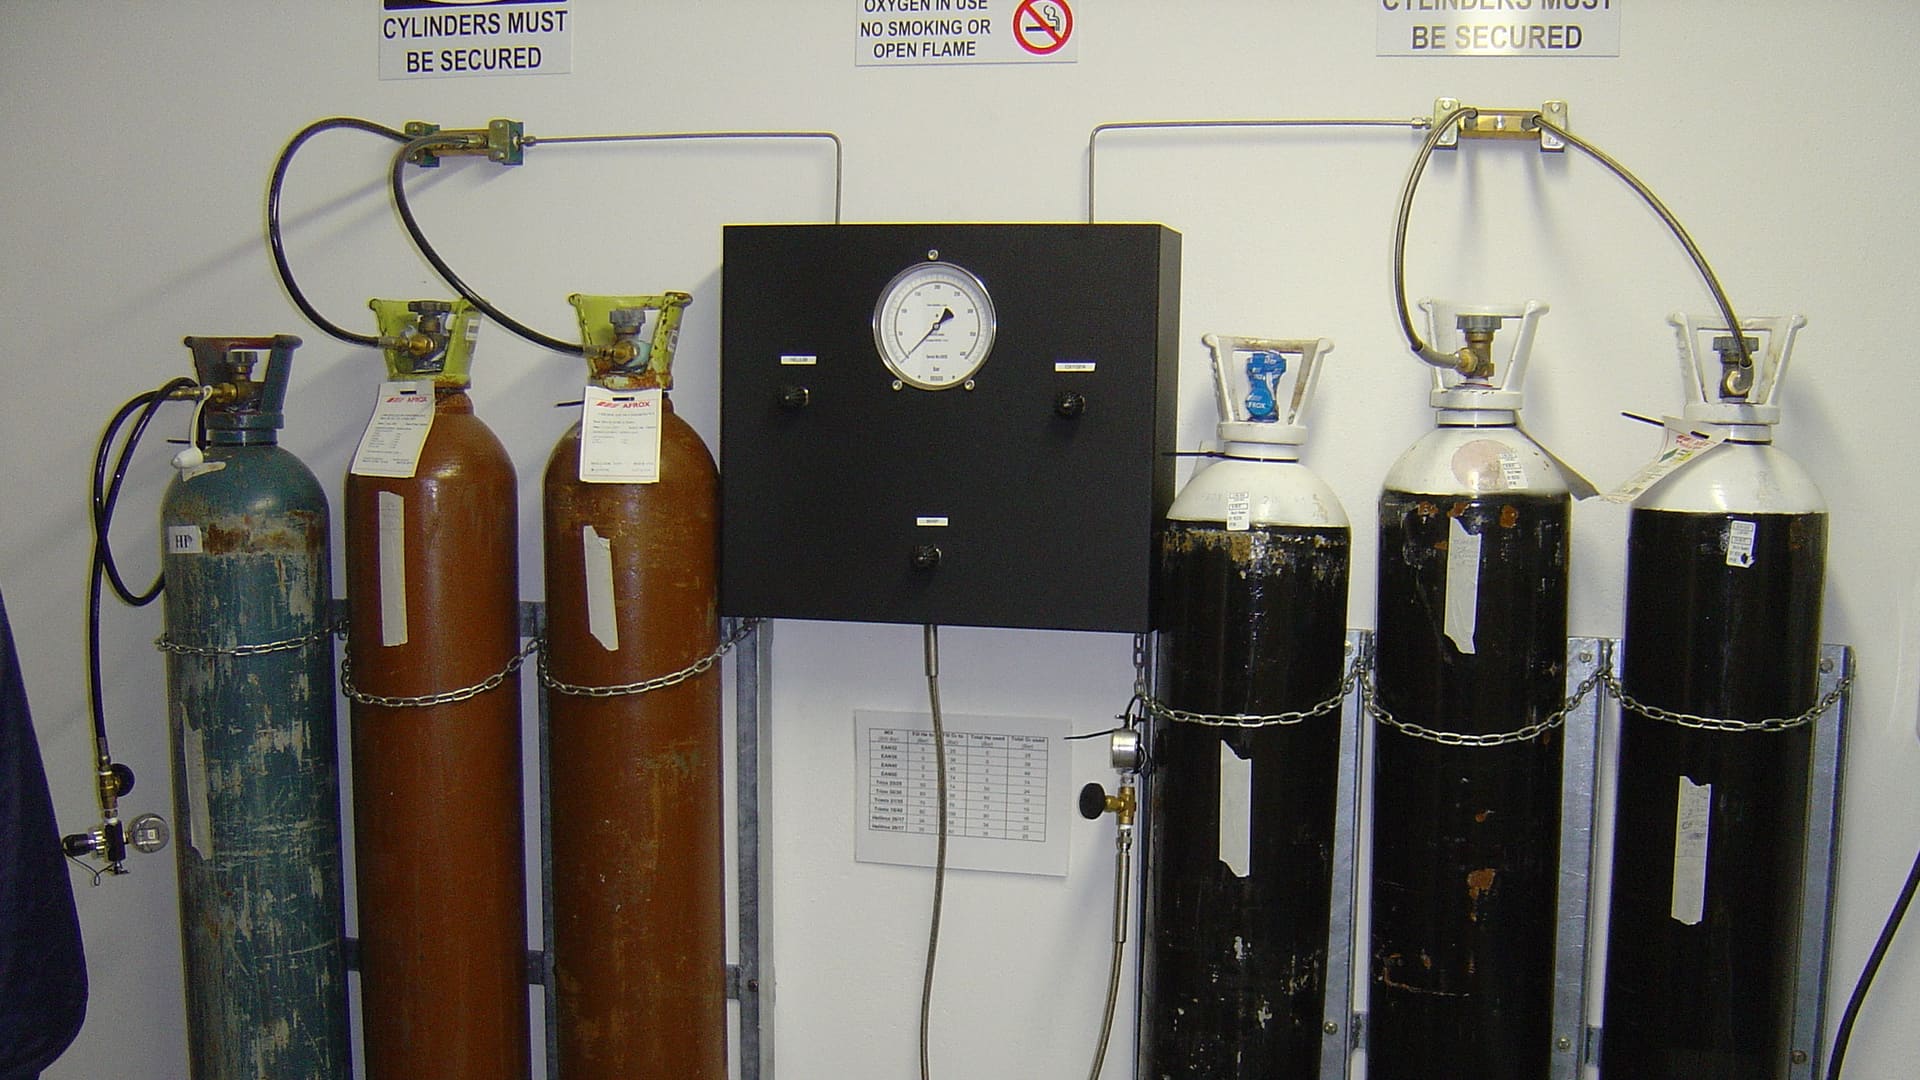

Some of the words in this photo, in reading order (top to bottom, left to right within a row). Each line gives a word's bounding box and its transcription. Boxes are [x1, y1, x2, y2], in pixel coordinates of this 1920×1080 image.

[864, 0, 930, 12] OXYGEN
[935, 0, 950, 11] IN
[958, 0, 988, 10] USE
[383, 13, 501, 40] CYLINDERS
[508, 10, 568, 34] MUST
[860, 22, 883, 37] NO
[888, 20, 963, 36] SMOKING
[967, 19, 990, 34] OR
[1412, 26, 1446, 49] BE
[1455, 25, 1582, 49] SECURED
[873, 42, 917, 58] OPEN
[922, 41, 976, 57] FLAME
[406, 51, 434, 73] BE
[440, 47, 542, 72] SECURED
[175, 535, 192, 548] HP
